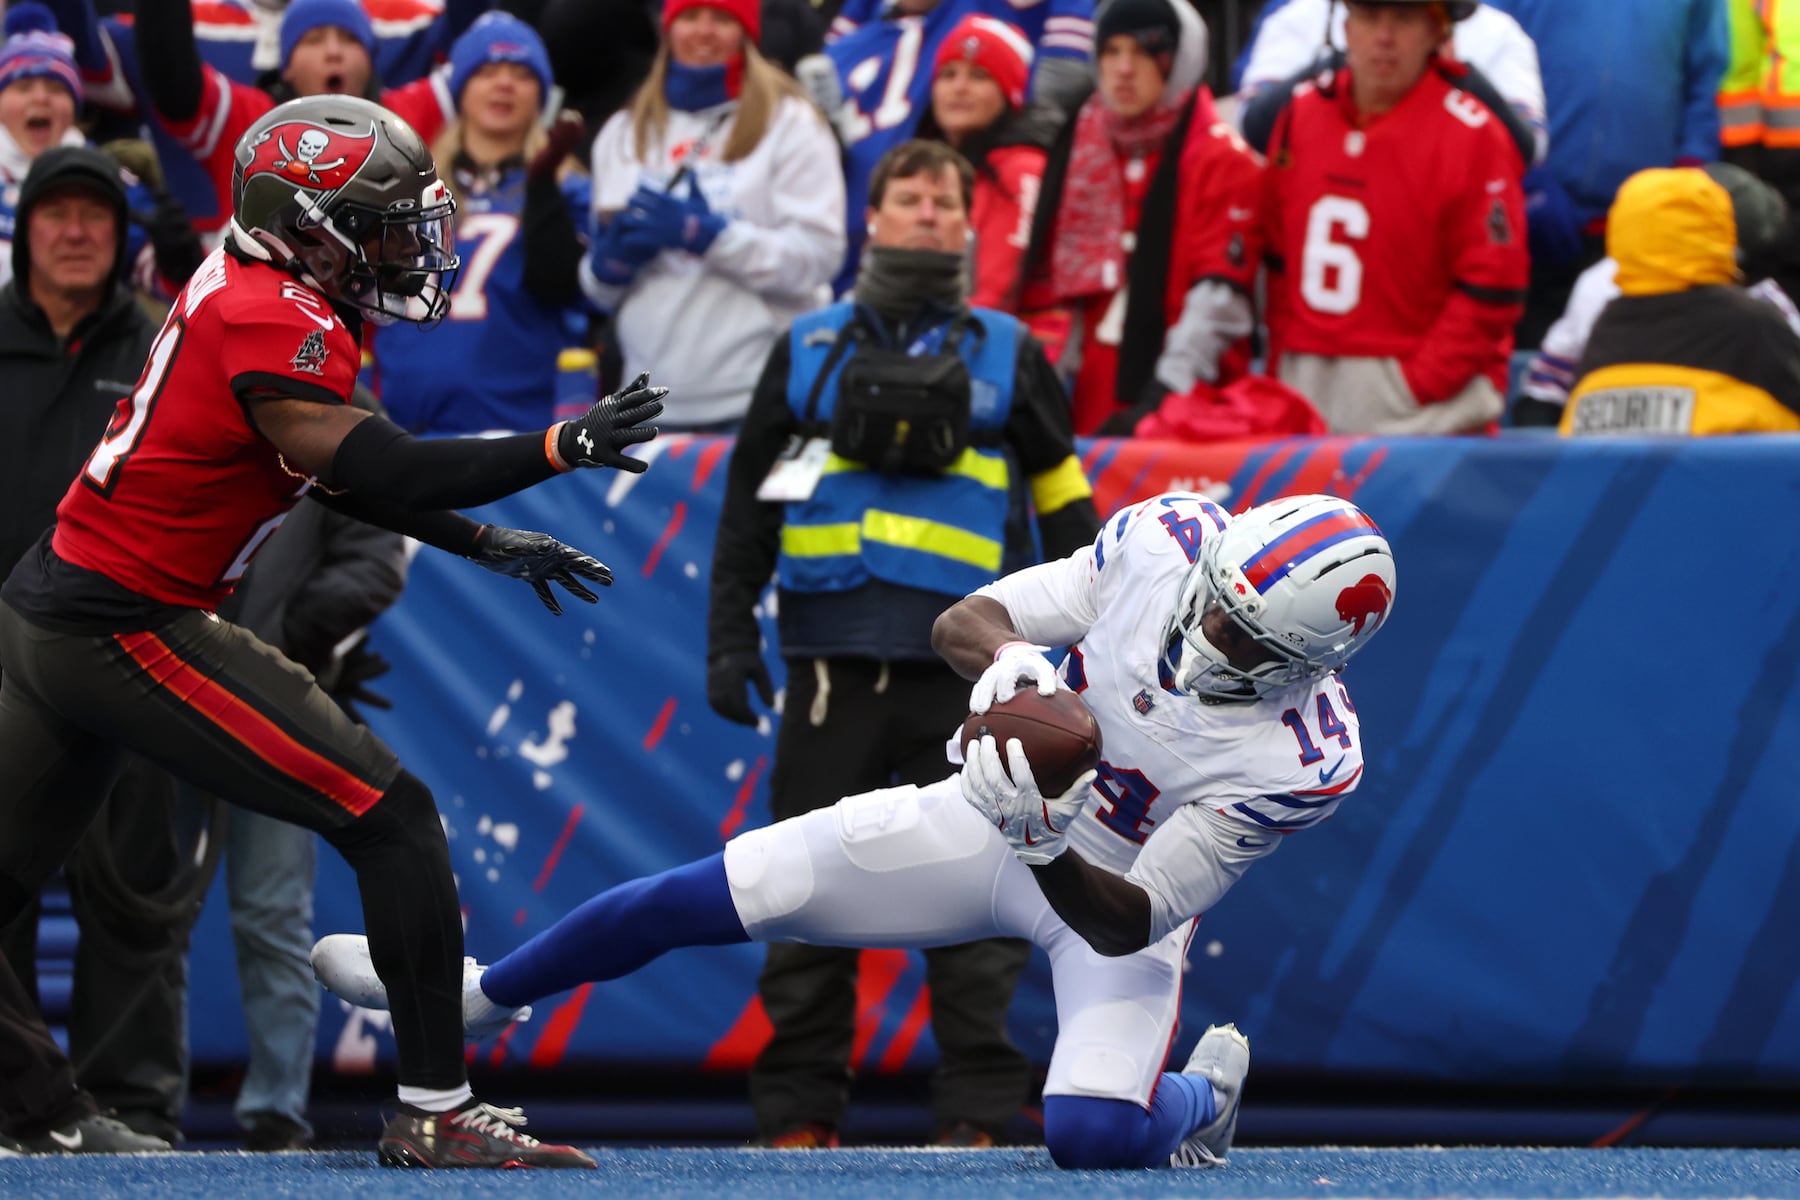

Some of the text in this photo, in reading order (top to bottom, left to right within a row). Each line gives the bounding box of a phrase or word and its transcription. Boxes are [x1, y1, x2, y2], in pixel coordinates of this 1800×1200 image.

[1301, 194, 1370, 316] 6
[80, 296, 187, 501] 1
[1575, 390, 1692, 436] SECURITY
[1281, 692, 1352, 767] 14
